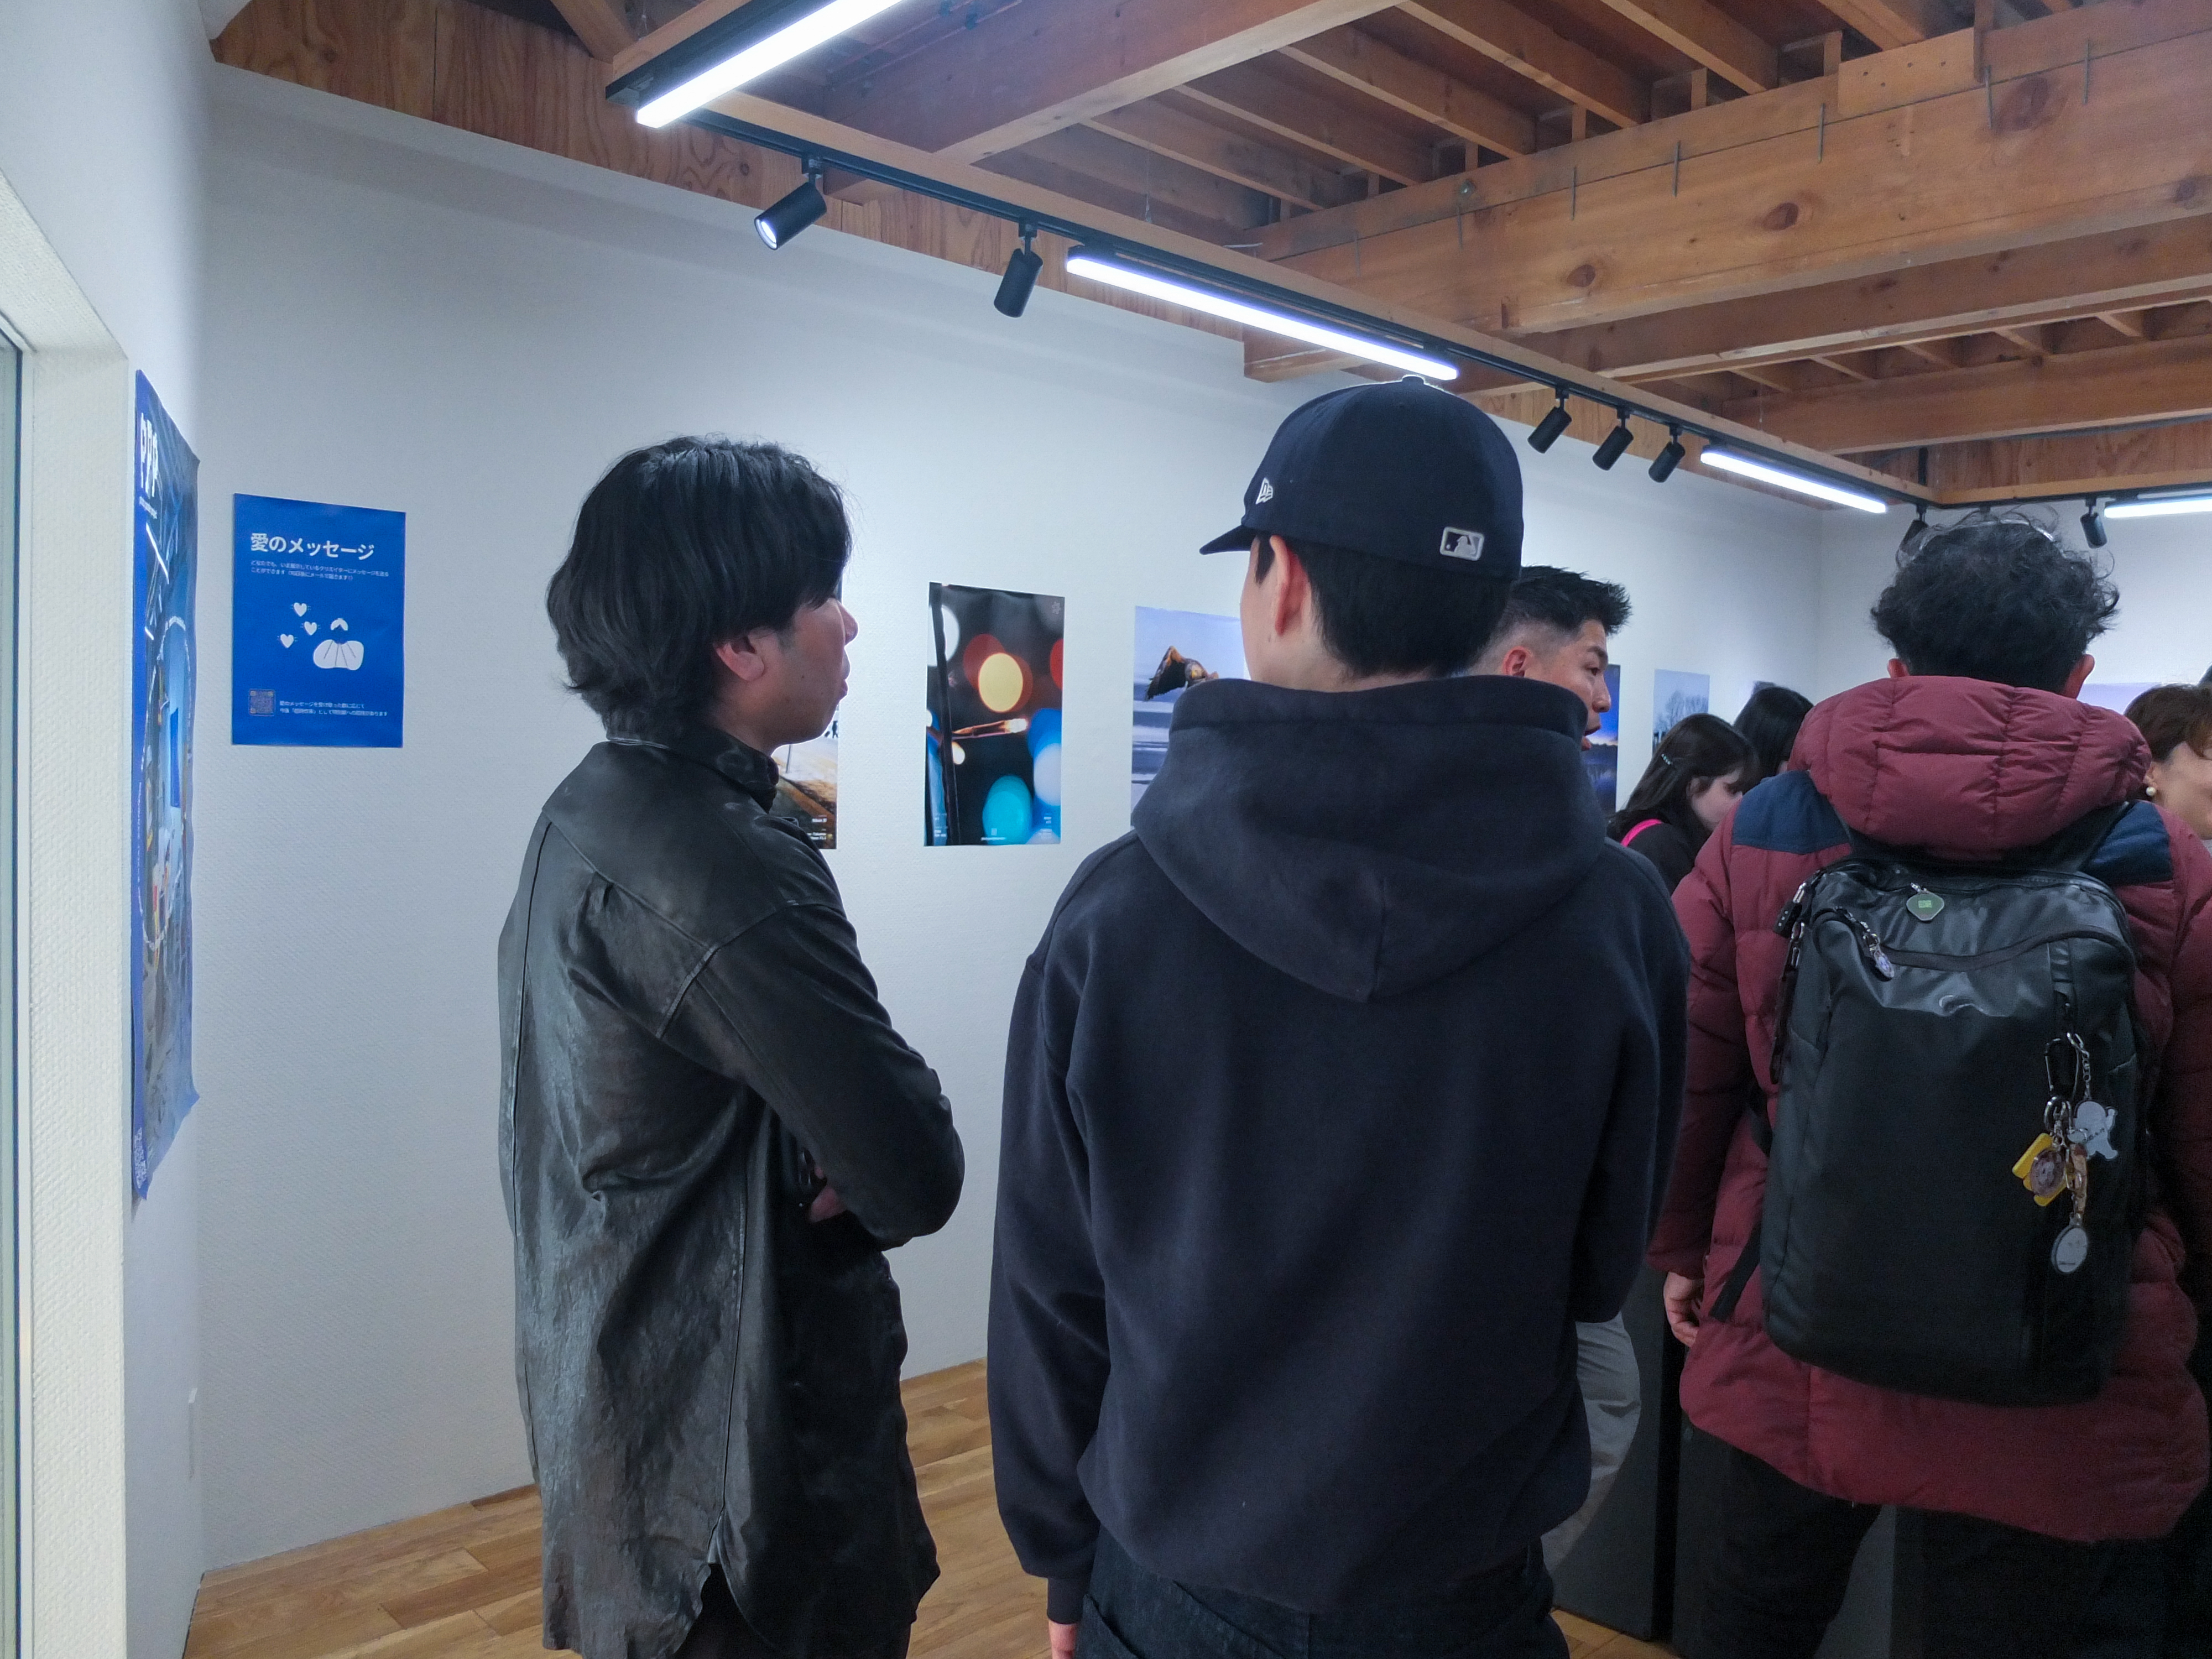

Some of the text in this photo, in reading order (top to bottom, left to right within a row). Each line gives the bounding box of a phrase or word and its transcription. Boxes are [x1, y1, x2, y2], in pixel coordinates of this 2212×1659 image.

[251, 533, 374, 560] 愛のメッセージ
